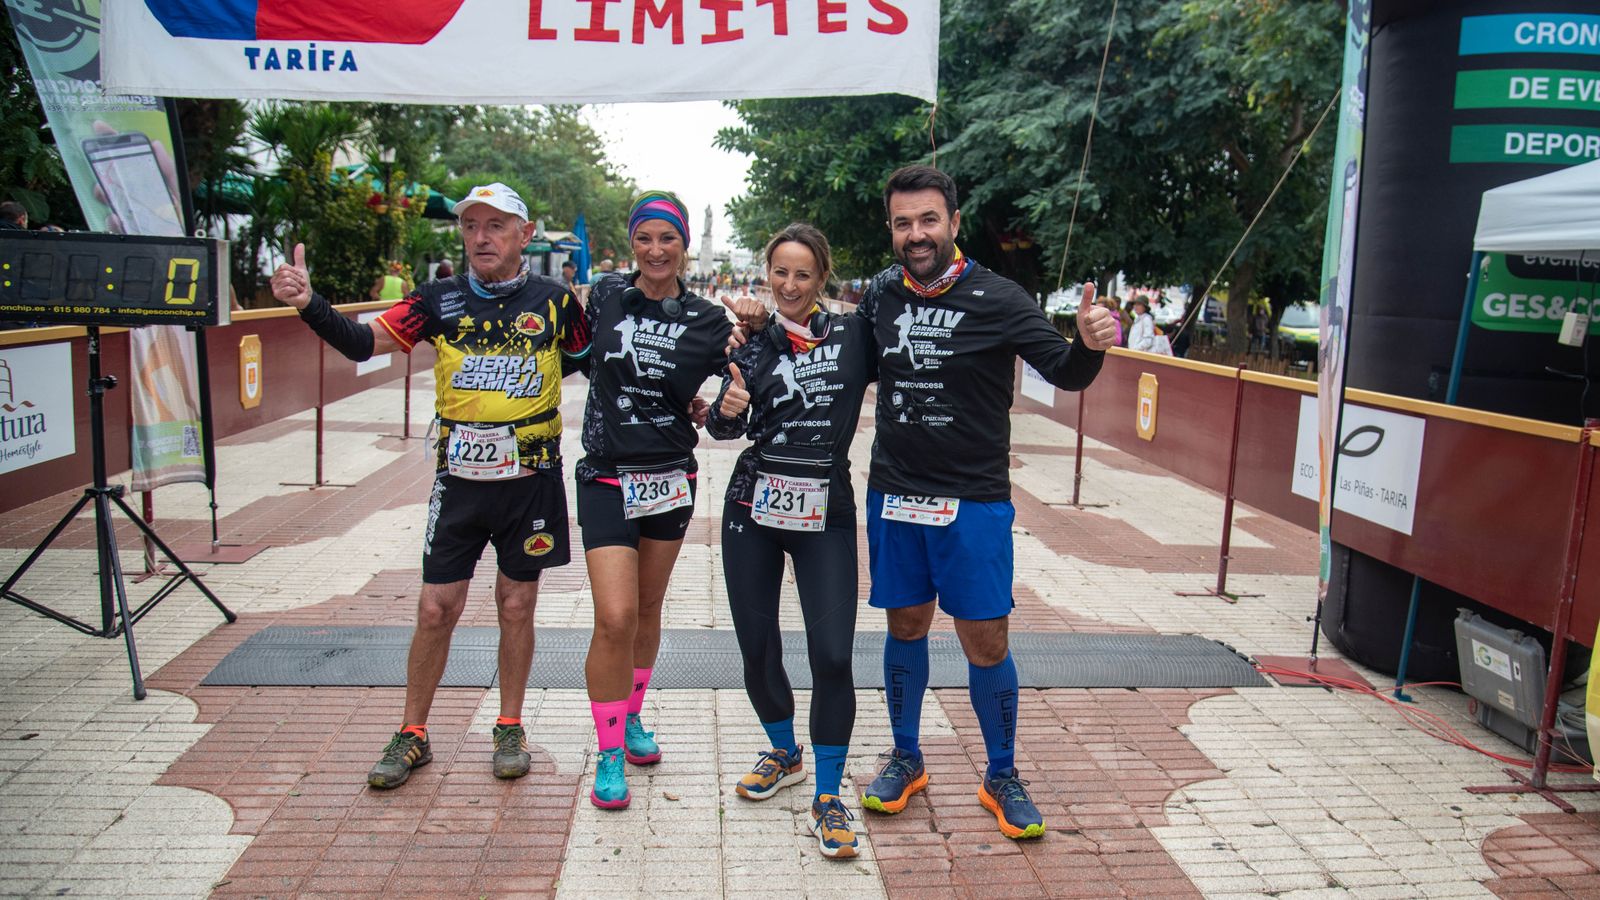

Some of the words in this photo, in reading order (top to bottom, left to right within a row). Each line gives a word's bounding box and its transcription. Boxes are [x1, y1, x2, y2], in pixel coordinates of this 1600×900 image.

[528, 0, 908, 45] LIMITES
[1514, 22, 1600, 46] CRON
[244, 43, 358, 72] TARIFA
[1508, 77, 1550, 99] DE
[54, 306, 71, 314] 615
[73, 306, 91, 314] 980
[118, 307, 207, 316] info@gesconchip.es
[914, 307, 966, 328] XIV
[639, 318, 688, 339] XIV
[909, 331, 952, 339] ESTRECHO
[633, 338, 676, 350] ESTRECHO
[634, 332, 674, 344] CARRERA
[638, 351, 661, 359] PEPE
[638, 357, 676, 369] SERRANO
[795, 344, 842, 366] XIV
[461, 355, 538, 374] SIERRA
[795, 361, 835, 373] CARRERA
[795, 366, 839, 378] ESTRECHO
[451, 372, 544, 392] BERMEJA
[805, 380, 827, 389] PEPE
[806, 384, 844, 394] SERRANO
[895, 381, 944, 389] metrovacesa
[459, 430, 477, 442] XIV
[461, 441, 498, 462] 222
[636, 480, 670, 501] 230
[767, 476, 788, 489] XIV
[1300, 462, 1314, 479] ECO
[1339, 476, 1351, 492] Las
[1354, 480, 1374, 499] Piñas
[1380, 487, 1408, 510] TARIFA
[770, 489, 806, 512] 231
